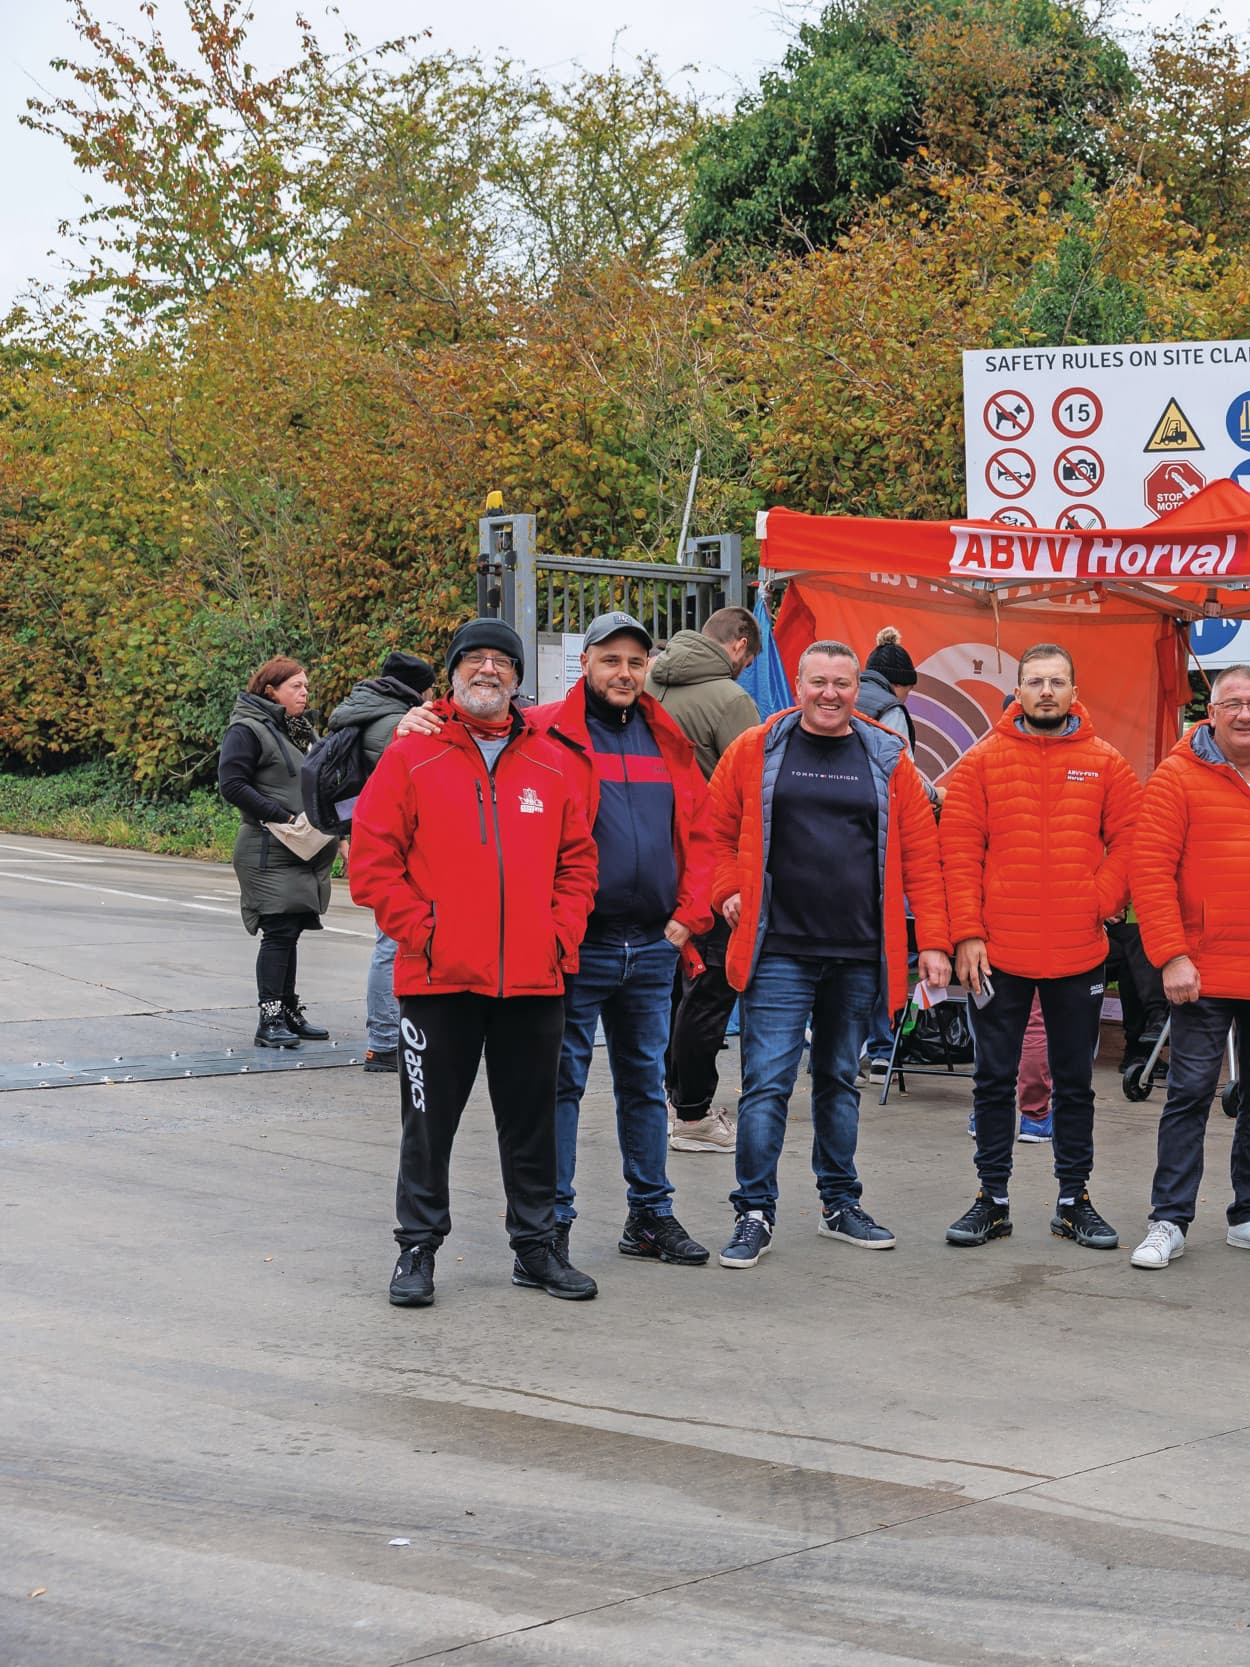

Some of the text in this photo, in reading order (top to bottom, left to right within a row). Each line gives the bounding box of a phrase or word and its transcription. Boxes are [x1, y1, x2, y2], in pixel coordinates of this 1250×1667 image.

[985, 353, 1056, 373] SAFETY
[1062, 351, 1124, 369] RULES
[1129, 350, 1157, 367] ON
[1163, 348, 1205, 366] SITE
[1064, 403, 1091, 423] 15
[1156, 493, 1183, 502] STOP
[961, 534, 1237, 575] ABVV Horval
[404, 1049, 426, 1113] asics
